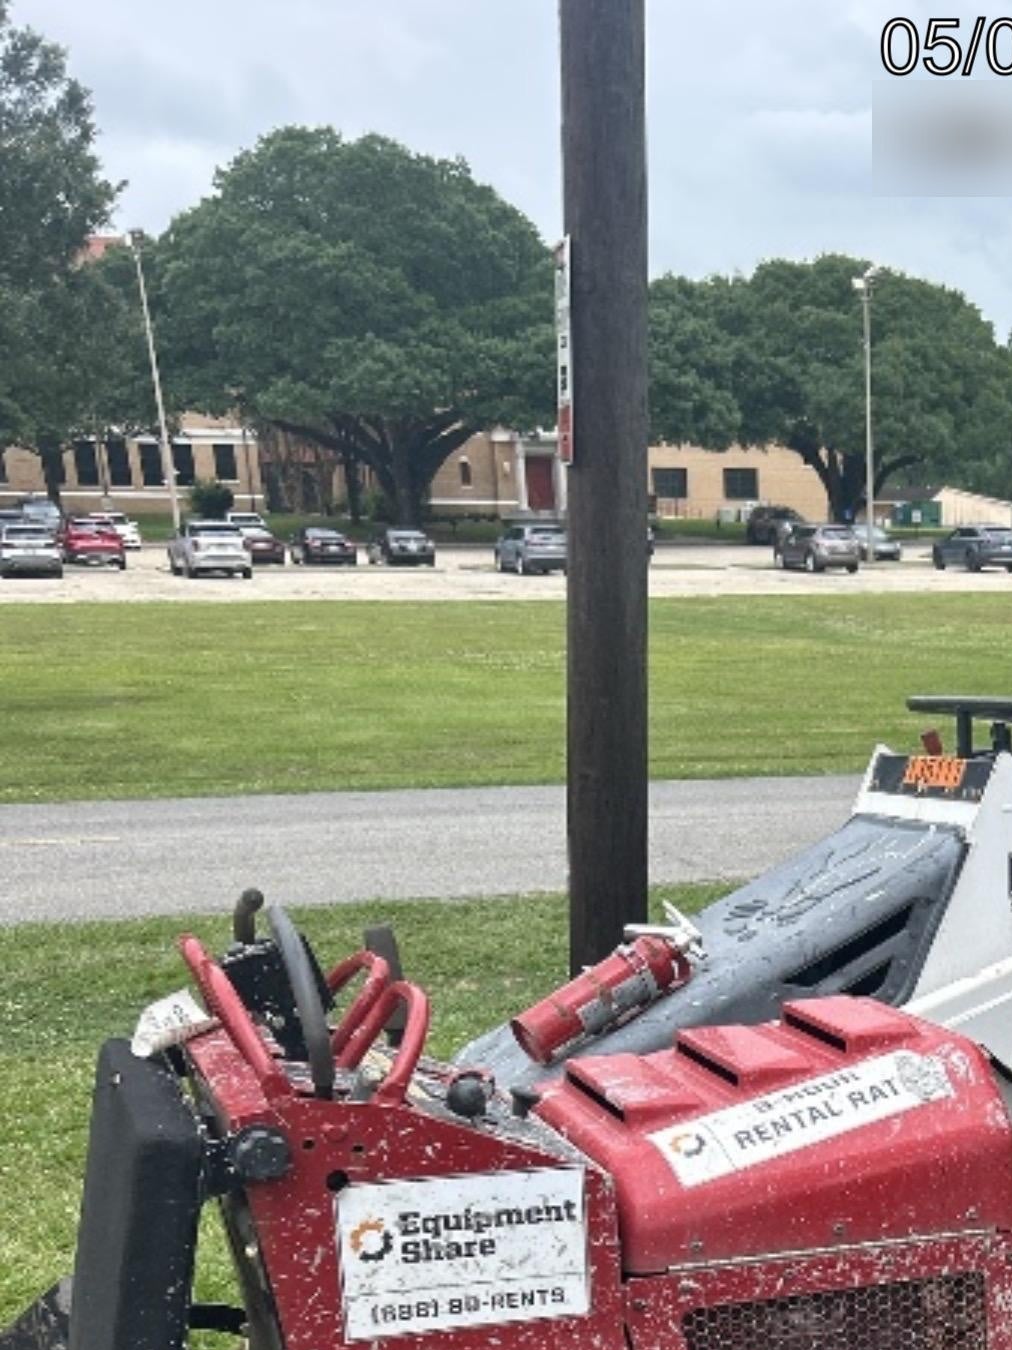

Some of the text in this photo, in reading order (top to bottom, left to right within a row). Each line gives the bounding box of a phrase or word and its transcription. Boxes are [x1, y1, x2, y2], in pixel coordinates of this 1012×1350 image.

[734, 1075, 904, 1150] RENTAL RAT
[398, 1199, 577, 1239] Equipment
[401, 1237, 496, 1264] Share
[371, 1287, 565, 1325] (888) 80-RENTS
